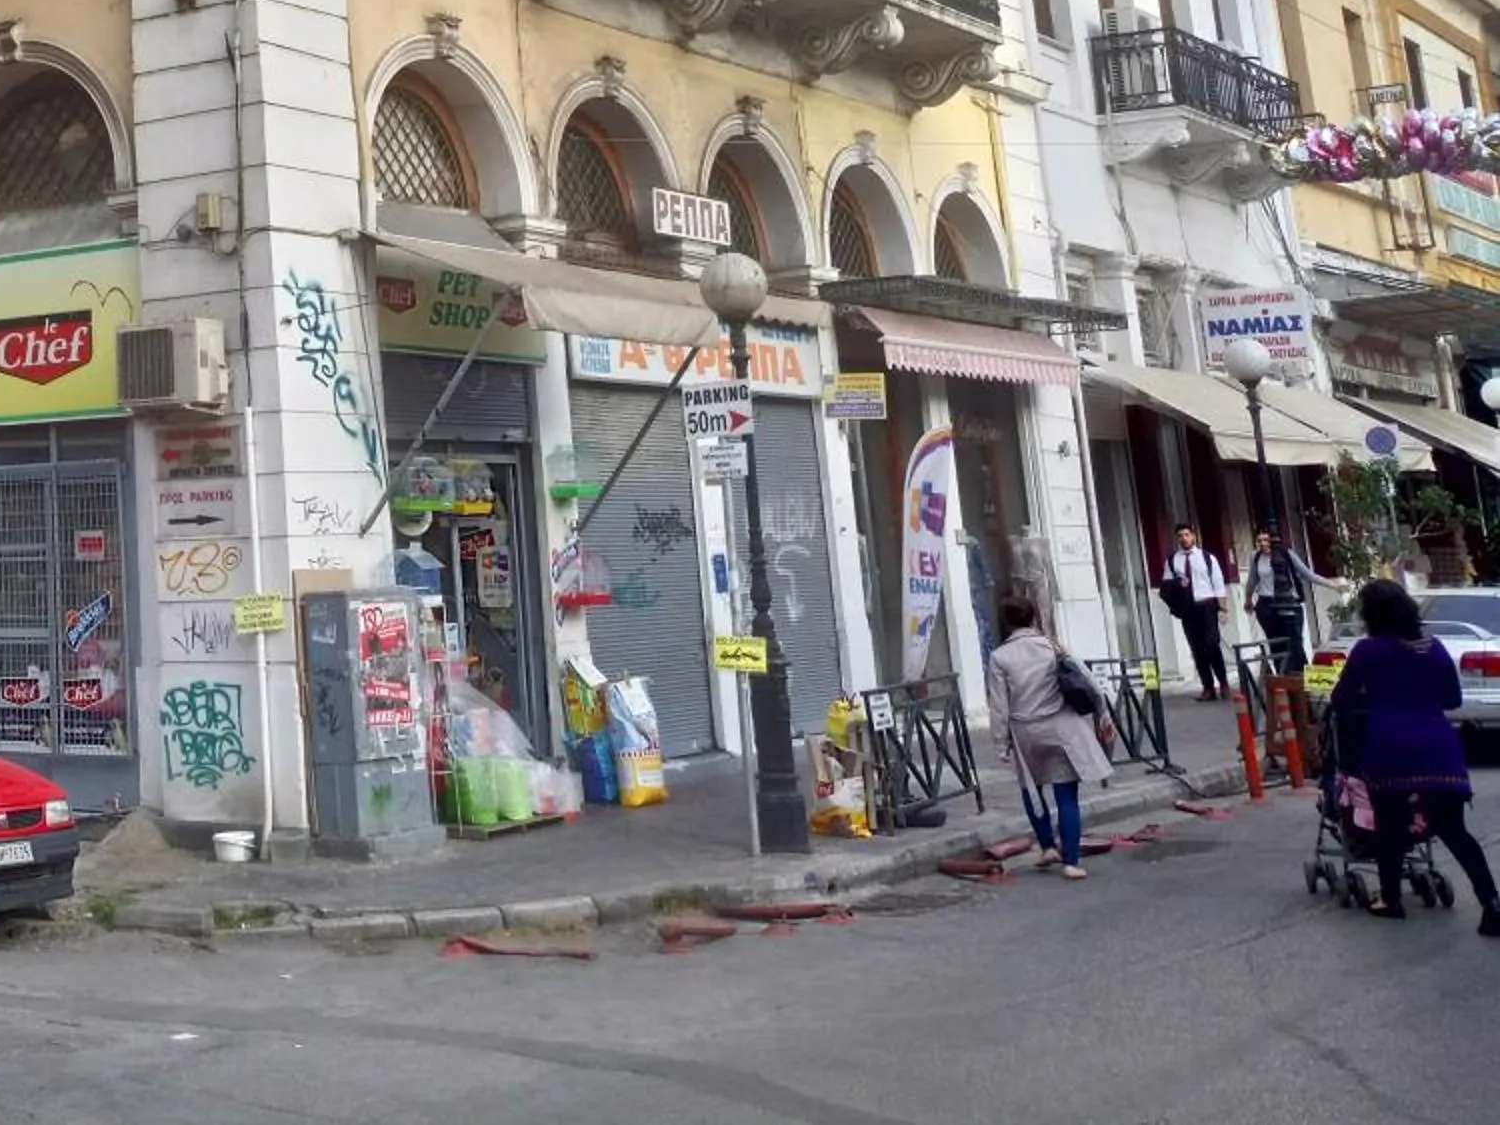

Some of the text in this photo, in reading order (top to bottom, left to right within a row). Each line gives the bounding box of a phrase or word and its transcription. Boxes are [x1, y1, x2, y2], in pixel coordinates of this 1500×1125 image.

[437, 270, 483, 297] PET
[428, 301, 491, 329] SHOP
[684, 384, 749, 407] PARKING
[688, 411, 727, 434] 50m
[189, 489, 233, 504] PARKING
